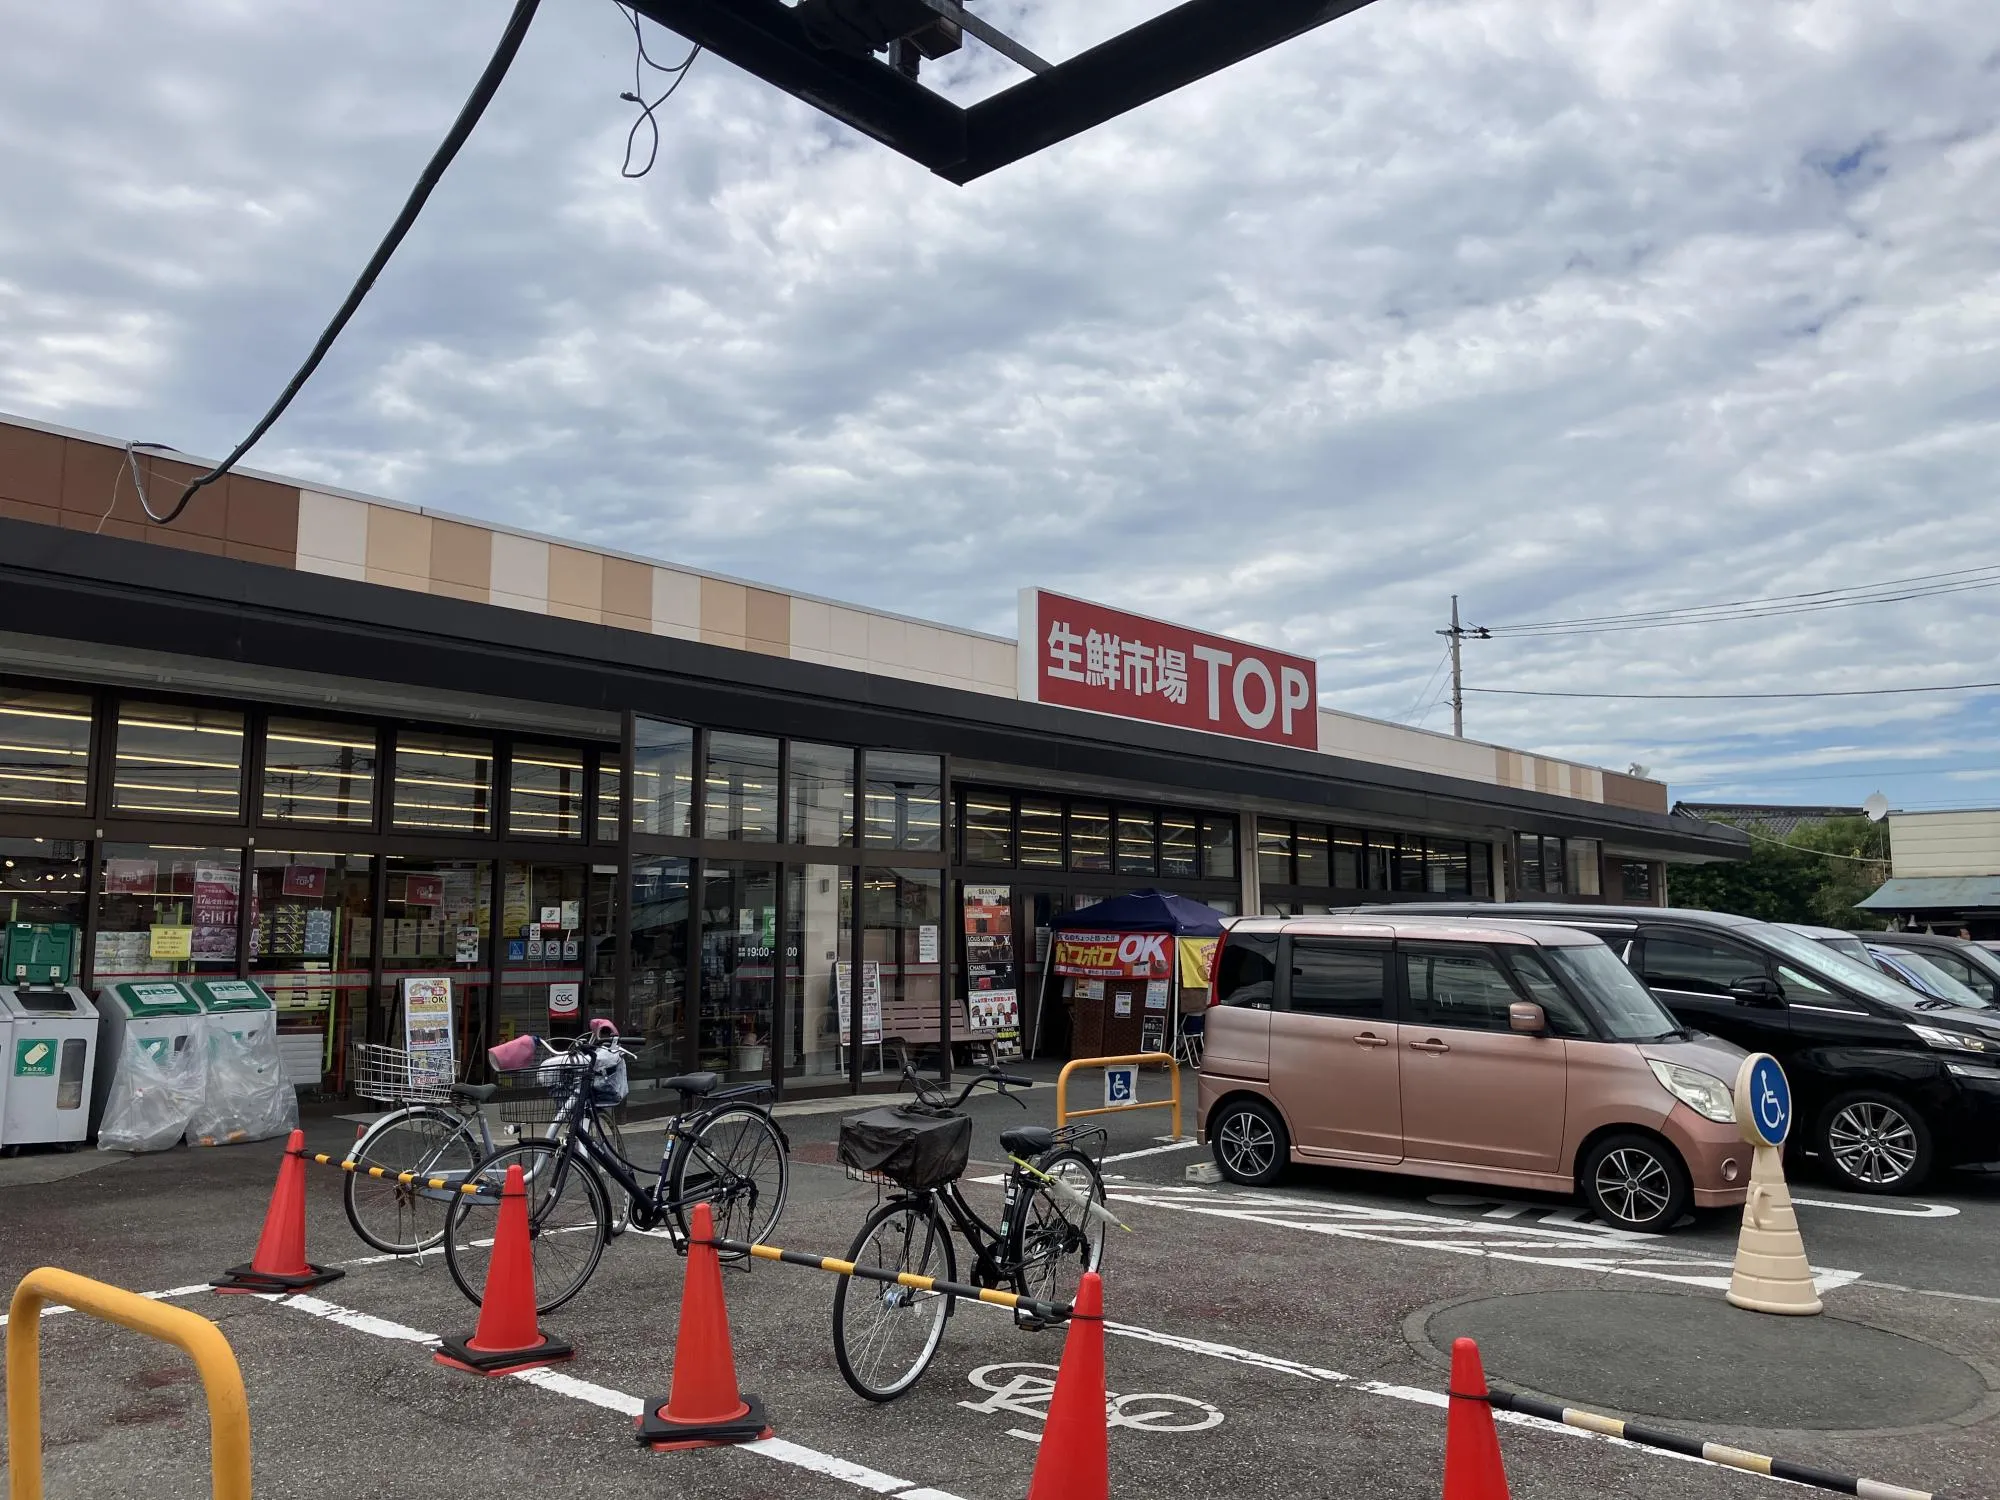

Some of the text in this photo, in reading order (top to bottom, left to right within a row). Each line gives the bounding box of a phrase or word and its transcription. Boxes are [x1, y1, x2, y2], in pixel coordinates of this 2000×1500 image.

[1048, 620, 1309, 735] 生鮮市場 TOP
[1118, 934, 1168, 963] OK
[431, 996, 447, 1004] OK!
[555, 993, 573, 1002] CGC
